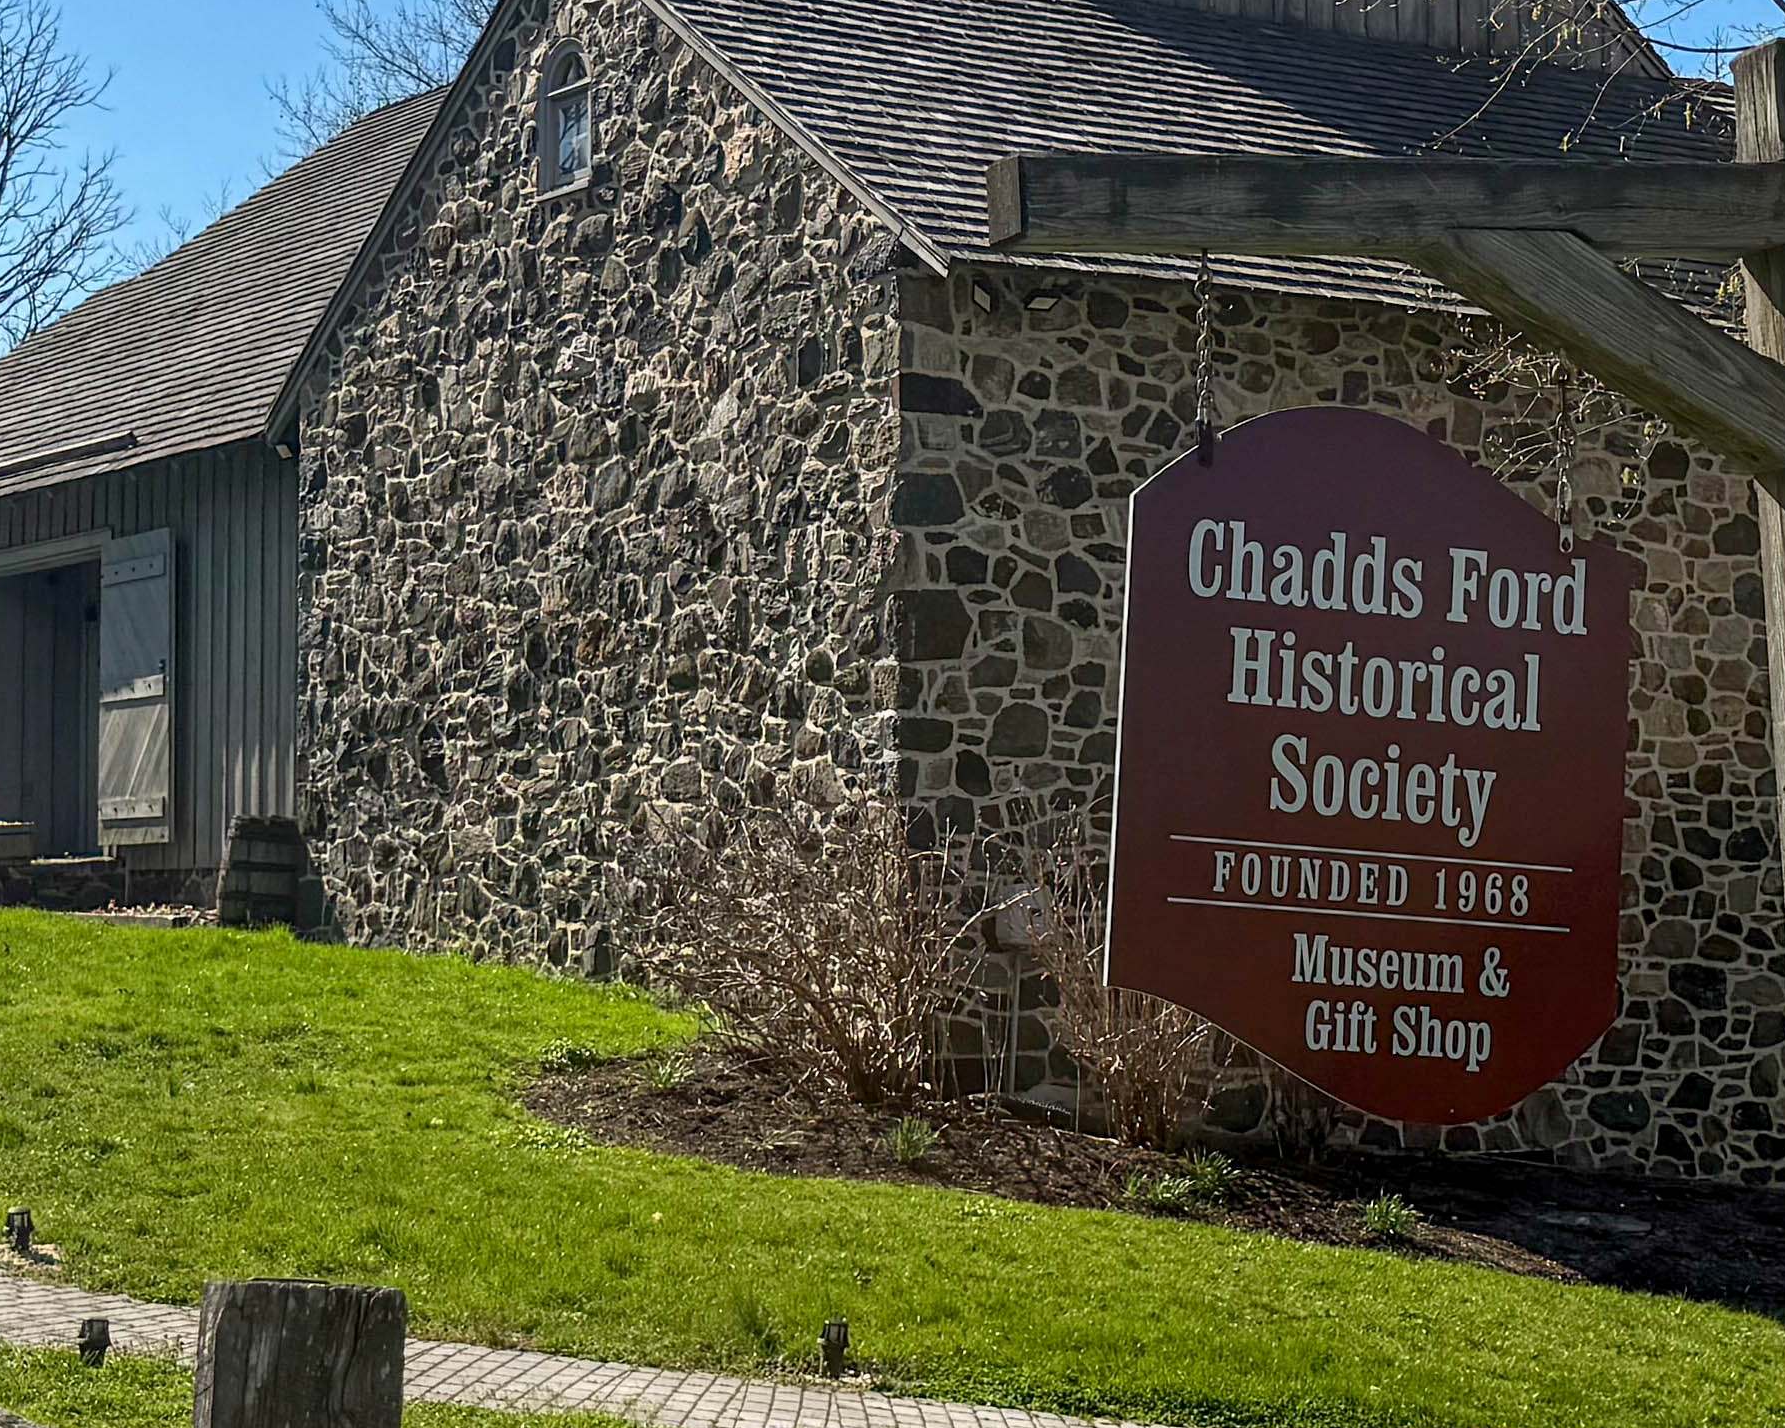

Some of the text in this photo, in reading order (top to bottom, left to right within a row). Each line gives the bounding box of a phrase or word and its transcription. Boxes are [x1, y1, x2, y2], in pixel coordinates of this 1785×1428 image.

[1188, 518, 1588, 636] Chadds Ford
[1227, 626, 1542, 732] Historical
[1270, 733, 1498, 848] Society
[1213, 850, 1531, 918] FOUNDED 1968
[1291, 933, 1510, 997] Museum &
[1305, 999, 1491, 1072] Gift Shop
